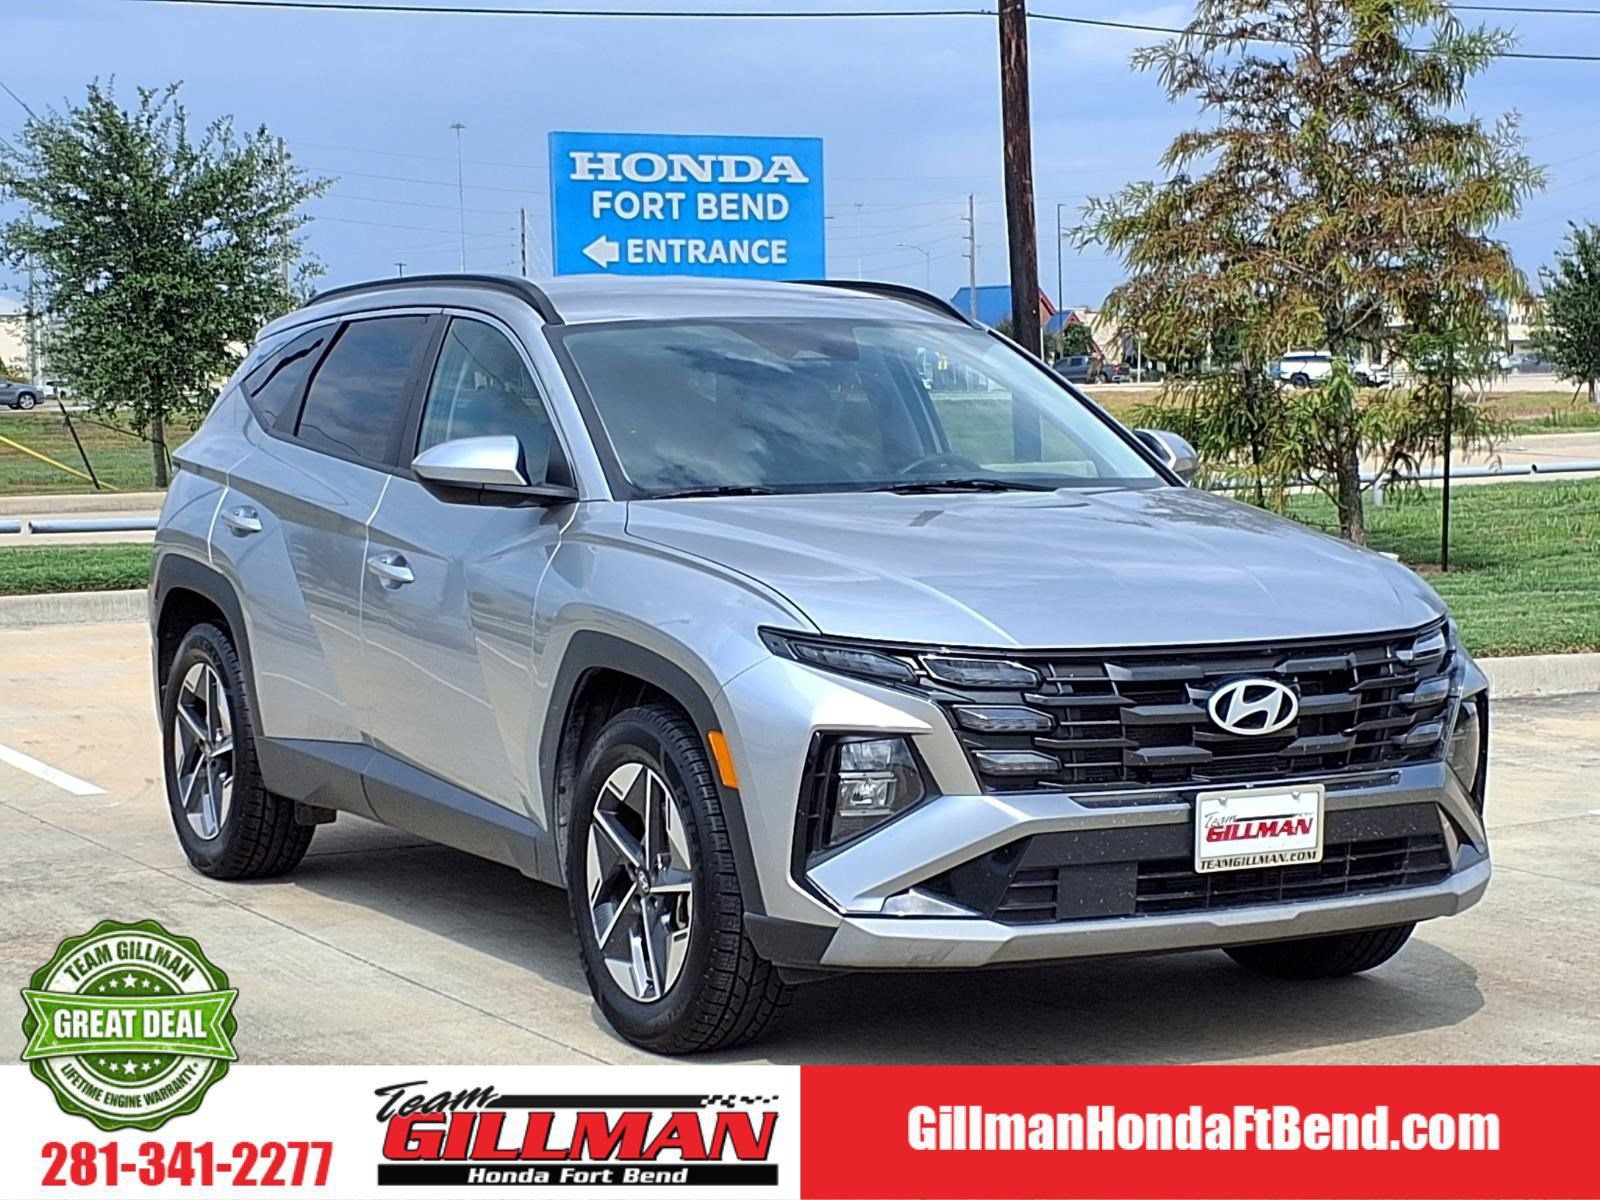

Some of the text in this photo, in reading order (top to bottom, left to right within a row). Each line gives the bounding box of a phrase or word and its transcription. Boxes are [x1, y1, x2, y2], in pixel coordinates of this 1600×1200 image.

[569, 151, 809, 183] HONDA
[592, 190, 789, 221] FORT BEND
[626, 239, 788, 264] ENTRANCE
[1206, 818, 1313, 842] GILLMAN
[1201, 851, 1317, 870] TEAMGILLMAN.COM
